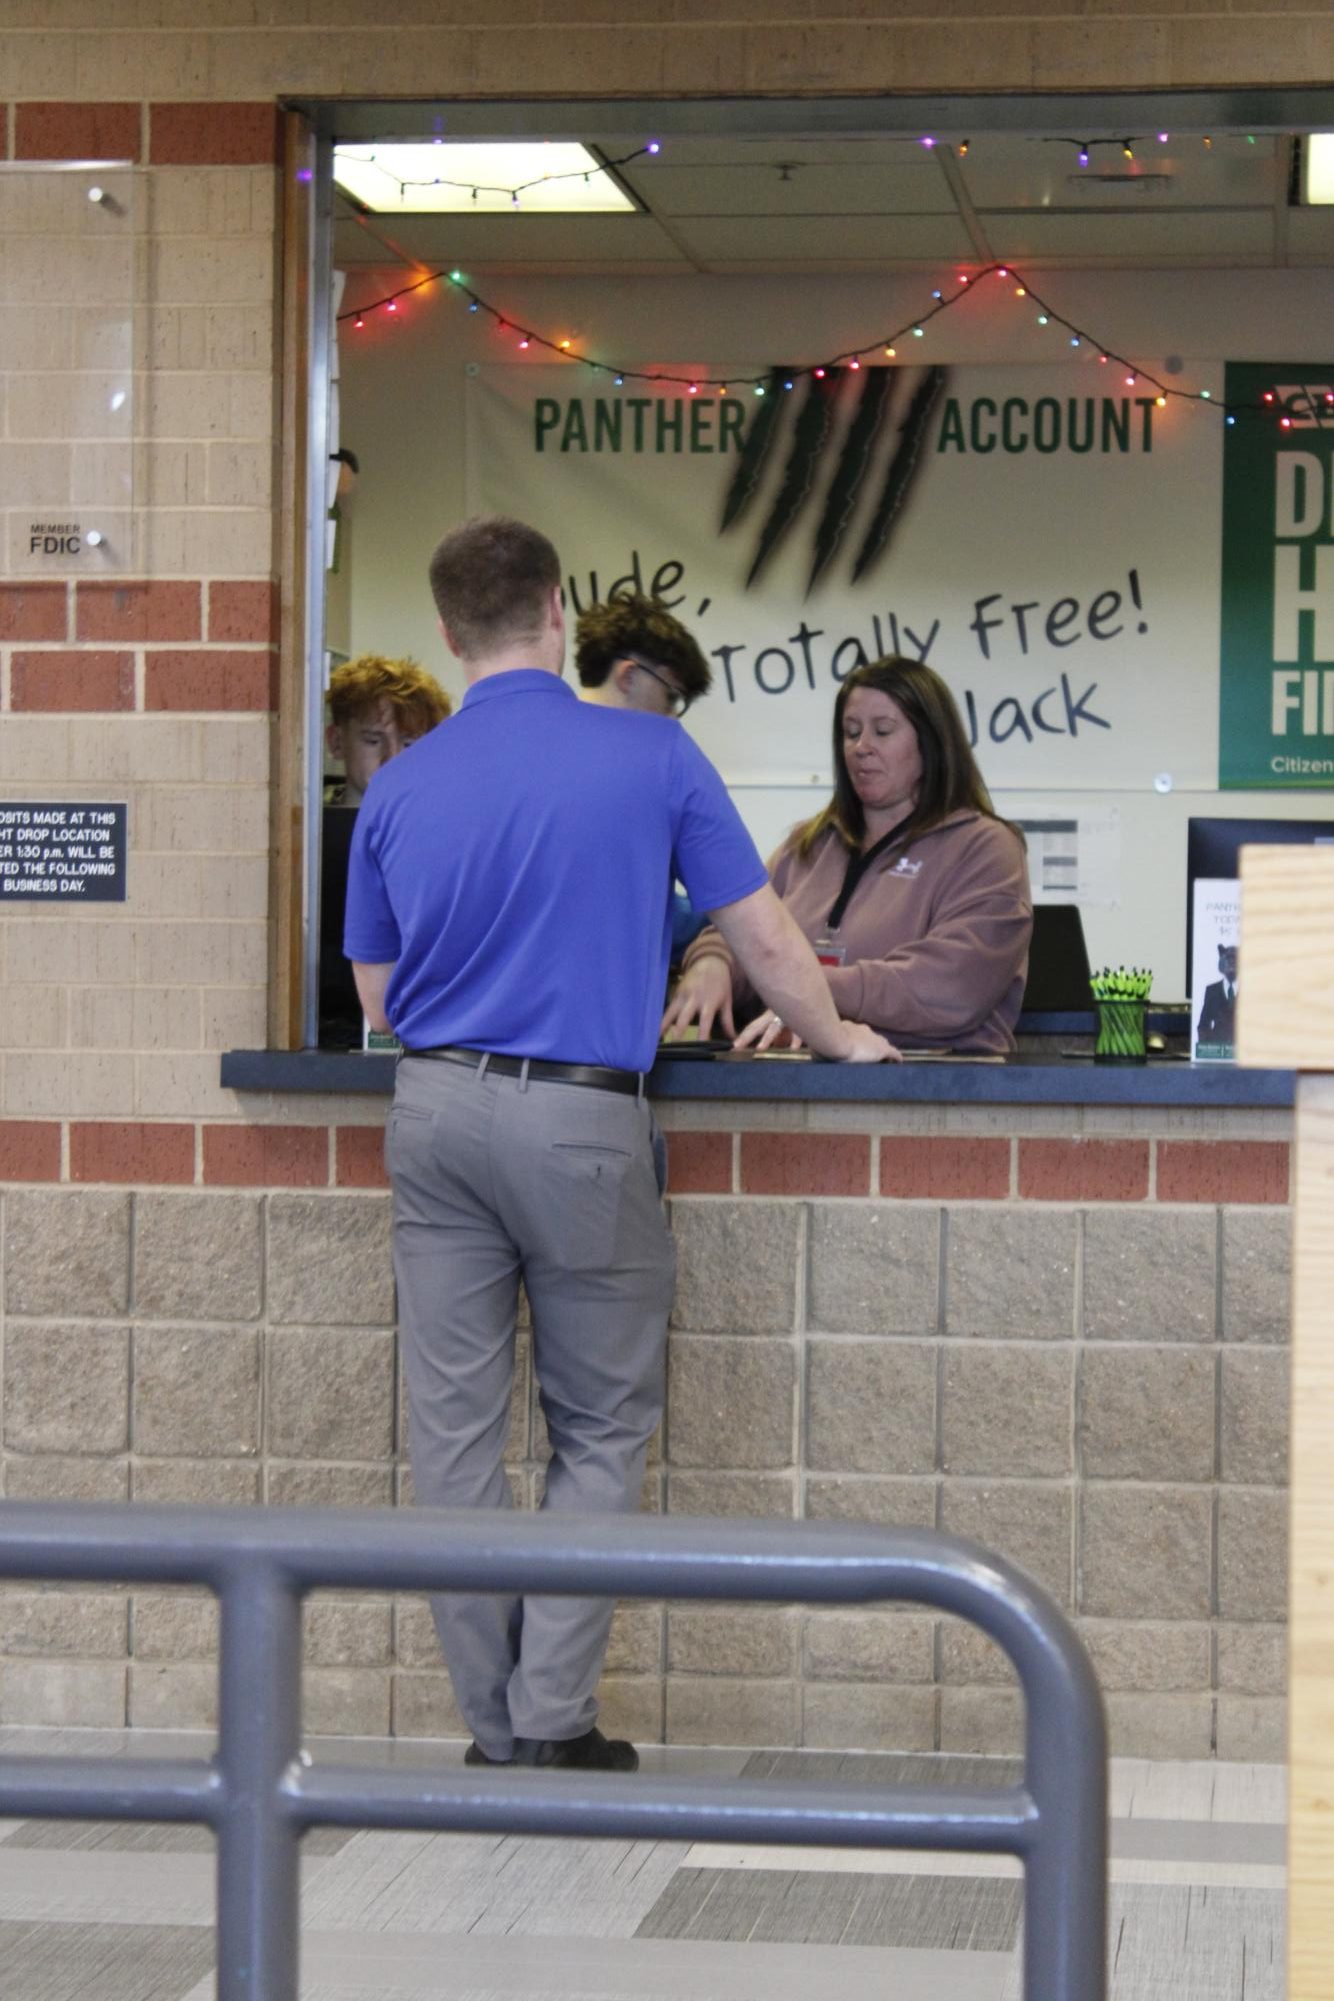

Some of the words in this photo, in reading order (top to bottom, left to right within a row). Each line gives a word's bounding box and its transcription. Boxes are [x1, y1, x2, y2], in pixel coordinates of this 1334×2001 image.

[534, 398, 746, 454] PANTHER
[937, 397, 1156, 453] ACCOUNT
[1275, 450, 1334, 538] D
[30, 524, 81, 534] MEMBER
[30, 536, 80, 554] FDIC
[561, 550, 711, 617] ude,
[969, 568, 1148, 660] Free!
[965, 672, 1112, 748] Jack
[33, 811, 66, 825] MADE
[69, 811, 86, 825] AT
[89, 812, 116, 825] THIS
[17, 828, 49, 841] DROP
[53, 829, 110, 842] LOCATION
[16, 845, 40, 858] 1:30
[43, 847, 64, 860] p.m.
[67, 846, 96, 858] WILL
[99, 846, 115, 858] BE
[23, 862, 46, 875] THE
[49, 862, 116, 875] FOLLOWING
[4, 878, 58, 892] BUSINESS
